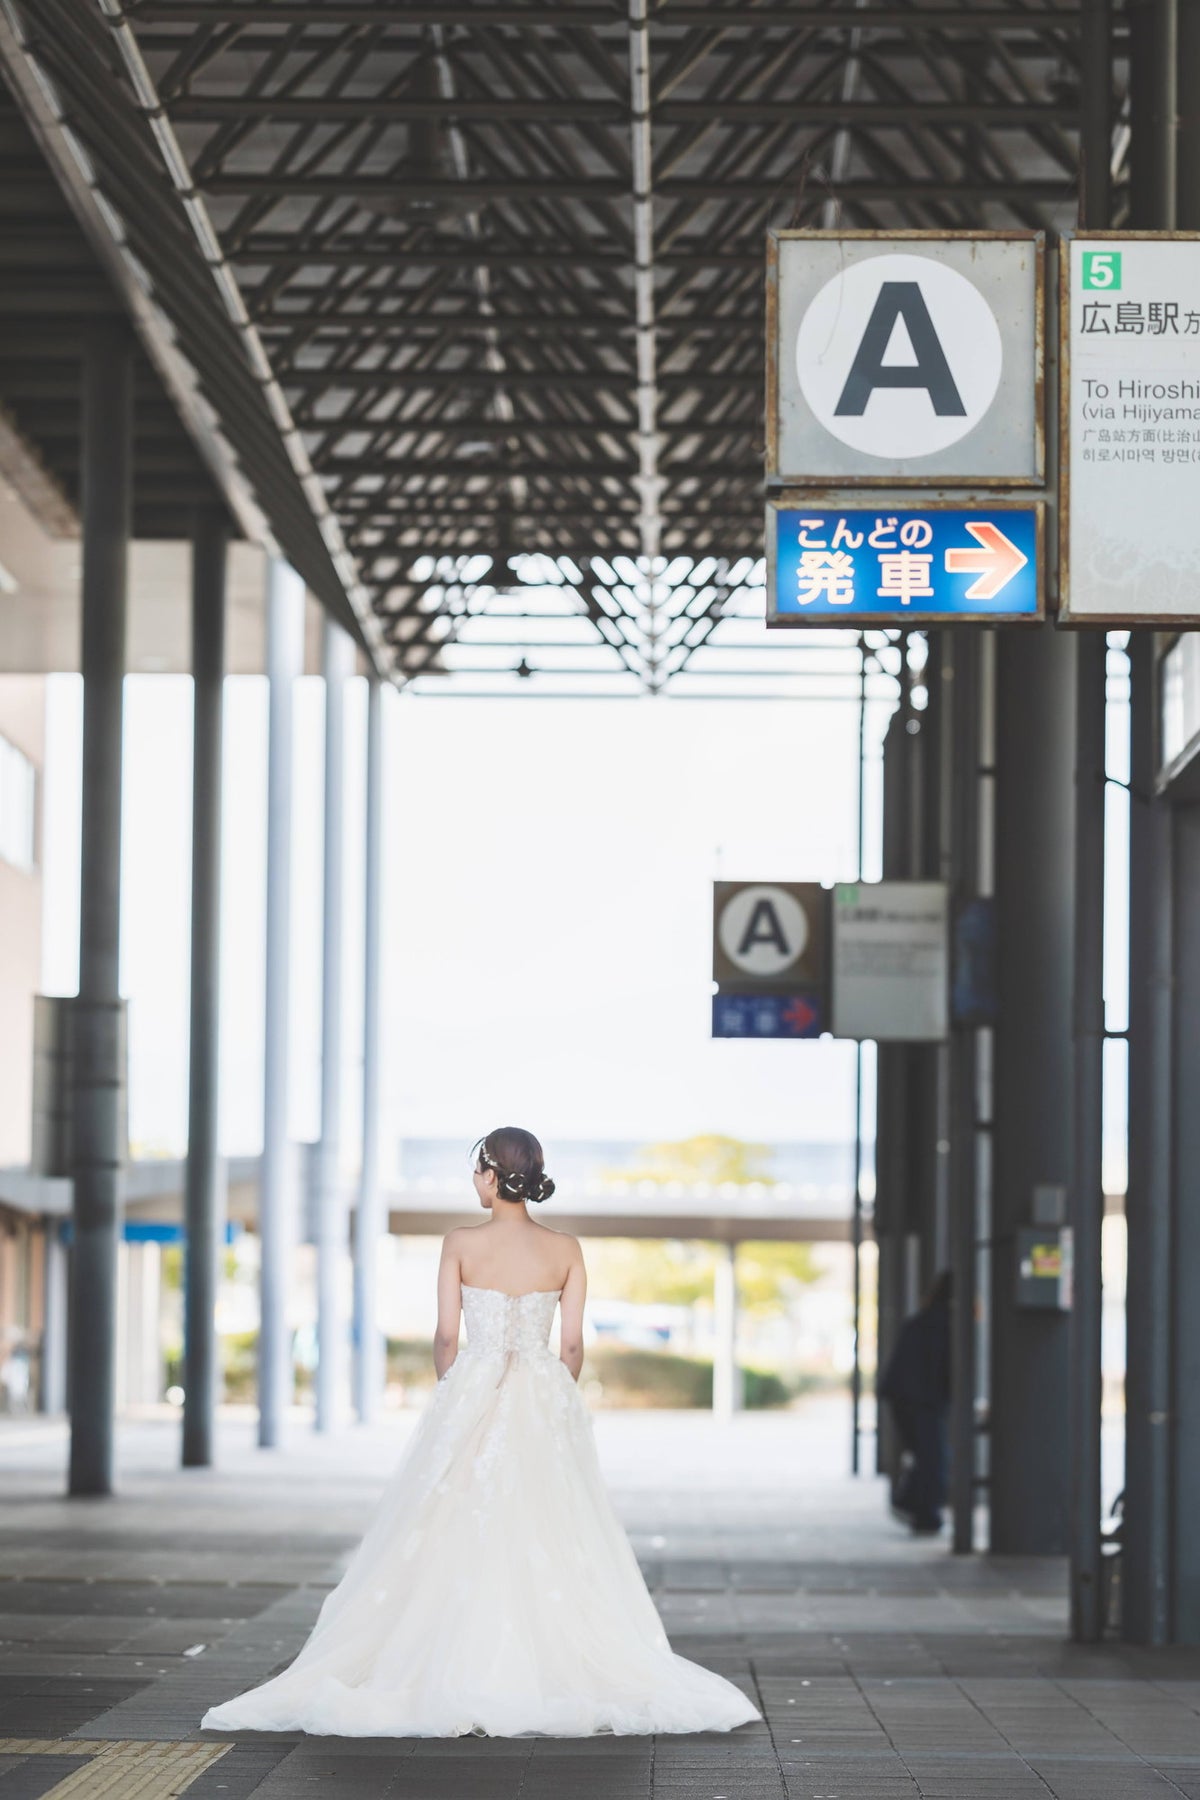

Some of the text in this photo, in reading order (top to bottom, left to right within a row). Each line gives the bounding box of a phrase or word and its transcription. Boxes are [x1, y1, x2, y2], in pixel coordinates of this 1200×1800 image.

[1089, 254, 1115, 288] 5
[1080, 300, 1200, 335] 広島駅方
[833, 281, 968, 417] A
[1081, 379, 1200, 399] To Hiroshi
[1082, 402, 1116, 420] (via
[1161, 448, 1200, 464] 방면(
[797, 517, 934, 549] こんどの
[796, 550, 935, 605] 発車
[736, 898, 791, 956] A
